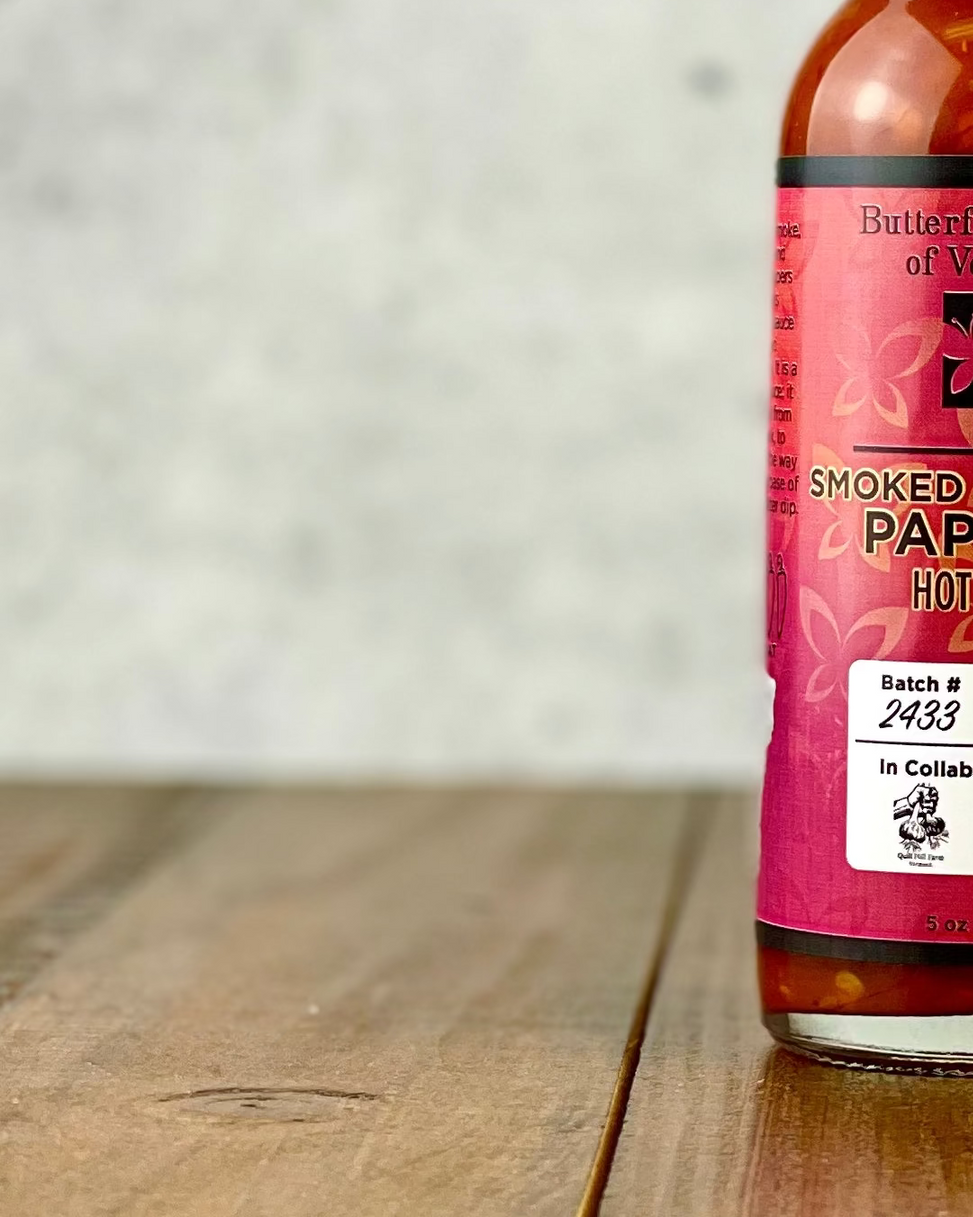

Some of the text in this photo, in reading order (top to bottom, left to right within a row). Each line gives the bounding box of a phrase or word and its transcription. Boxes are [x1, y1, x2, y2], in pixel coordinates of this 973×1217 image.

[906, 245, 939, 275] of
[810, 467, 967, 504] SMOKED
[881, 674, 961, 693] Batch #
[879, 698, 961, 731] 2433
[880, 758, 898, 775] In
[927, 915, 938, 932] 5
[944, 919, 968, 933] oz
